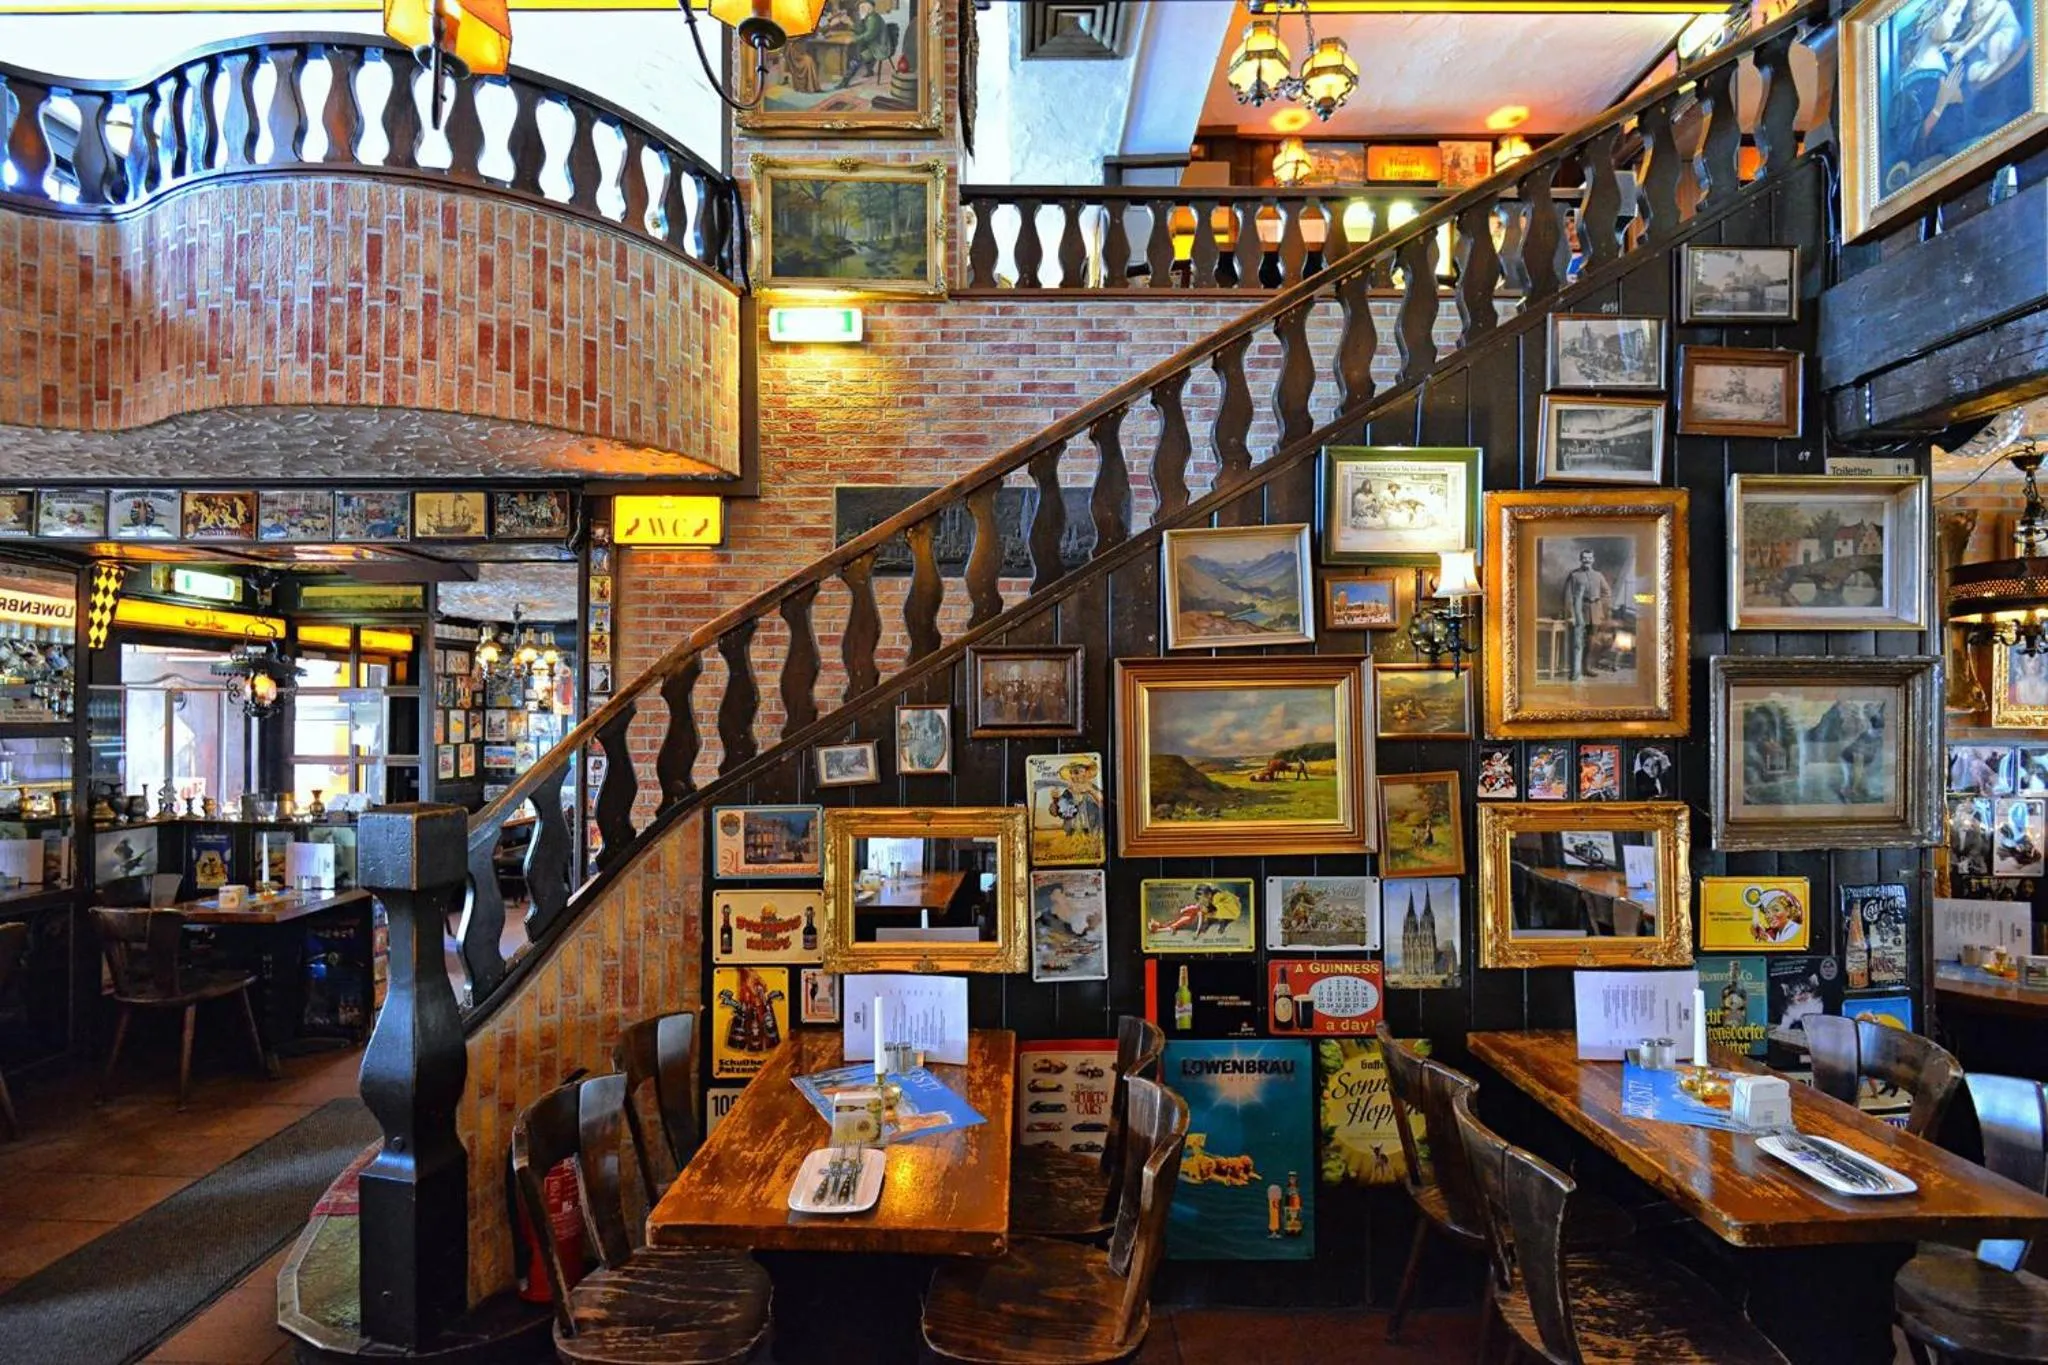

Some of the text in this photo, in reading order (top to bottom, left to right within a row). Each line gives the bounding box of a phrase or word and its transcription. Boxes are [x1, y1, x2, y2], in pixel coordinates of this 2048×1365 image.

[1831, 465, 1873, 477] Toiletten
[1295, 962, 1380, 975] A GUINNESS
[1326, 1019, 1377, 1035] a day!
[1331, 1071, 1390, 1099] Sonn
